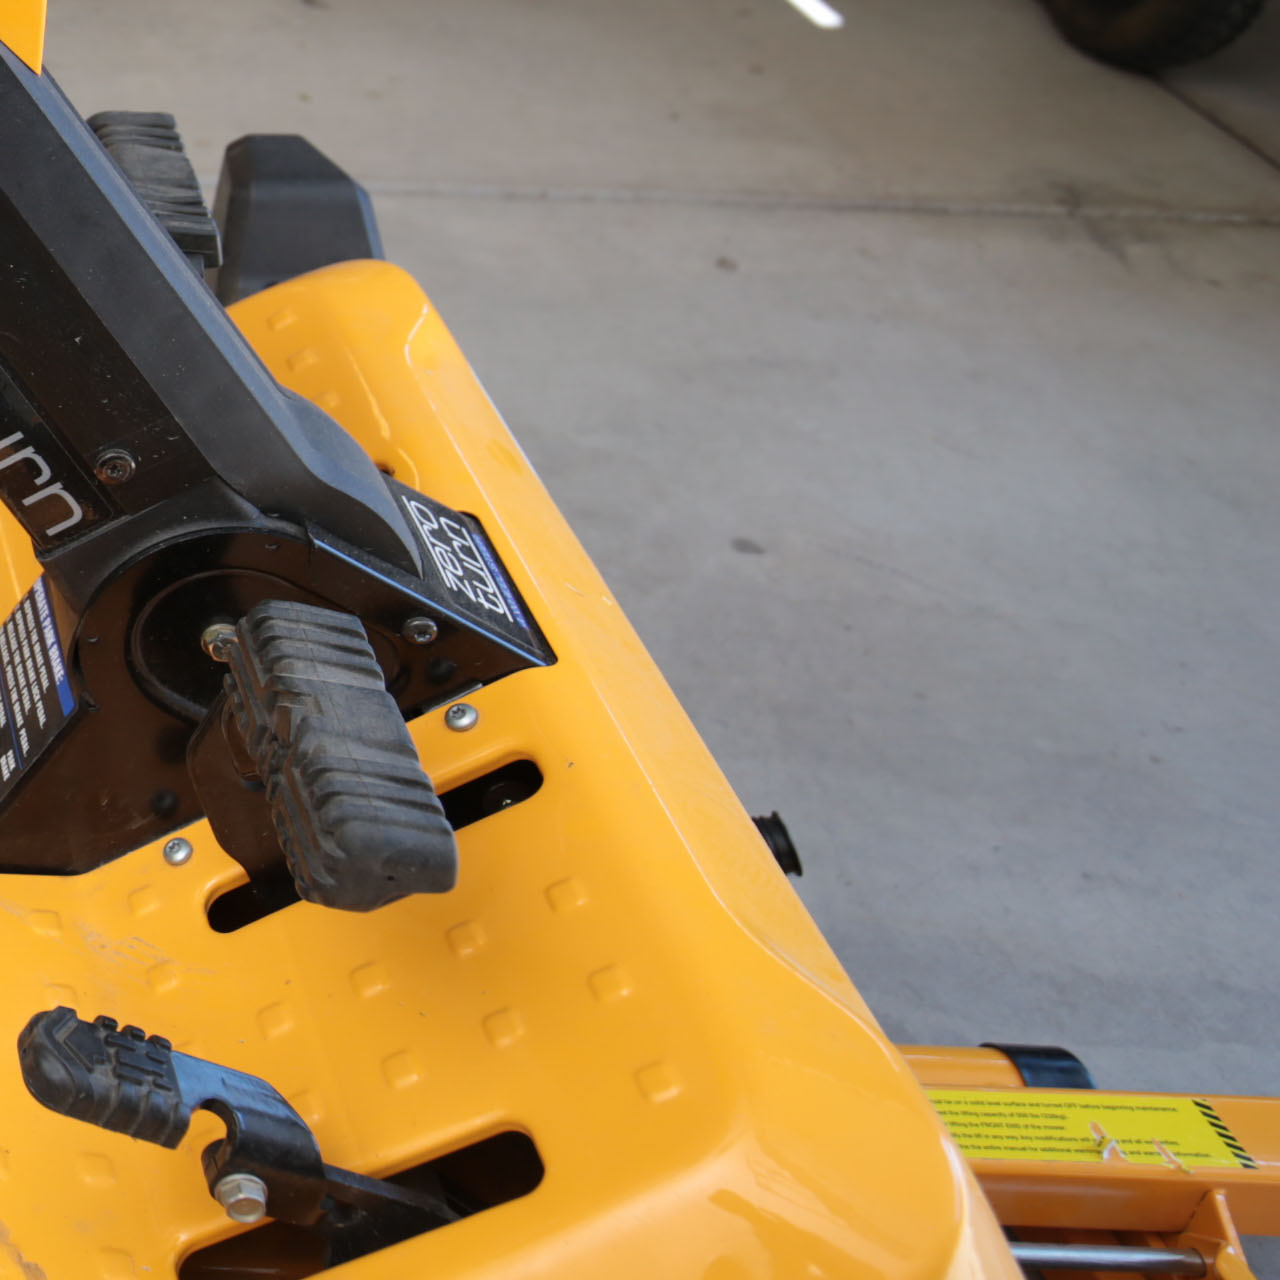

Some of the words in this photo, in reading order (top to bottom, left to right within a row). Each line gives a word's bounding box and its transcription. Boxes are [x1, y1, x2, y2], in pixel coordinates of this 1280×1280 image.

[409, 499, 477, 602] zero
[439, 516, 506, 615] turn
[42, 616, 55, 648] PARK
[21, 638, 29, 660] PARK
[26, 657, 35, 684] BRAKE
[31, 680, 39, 703] LOCK
[33, 641, 42, 668] BRAKE
[48, 643, 64, 687] BRAKE:
[16, 663, 25, 689] BRAKE
[13, 701, 22, 728] BRAKE
